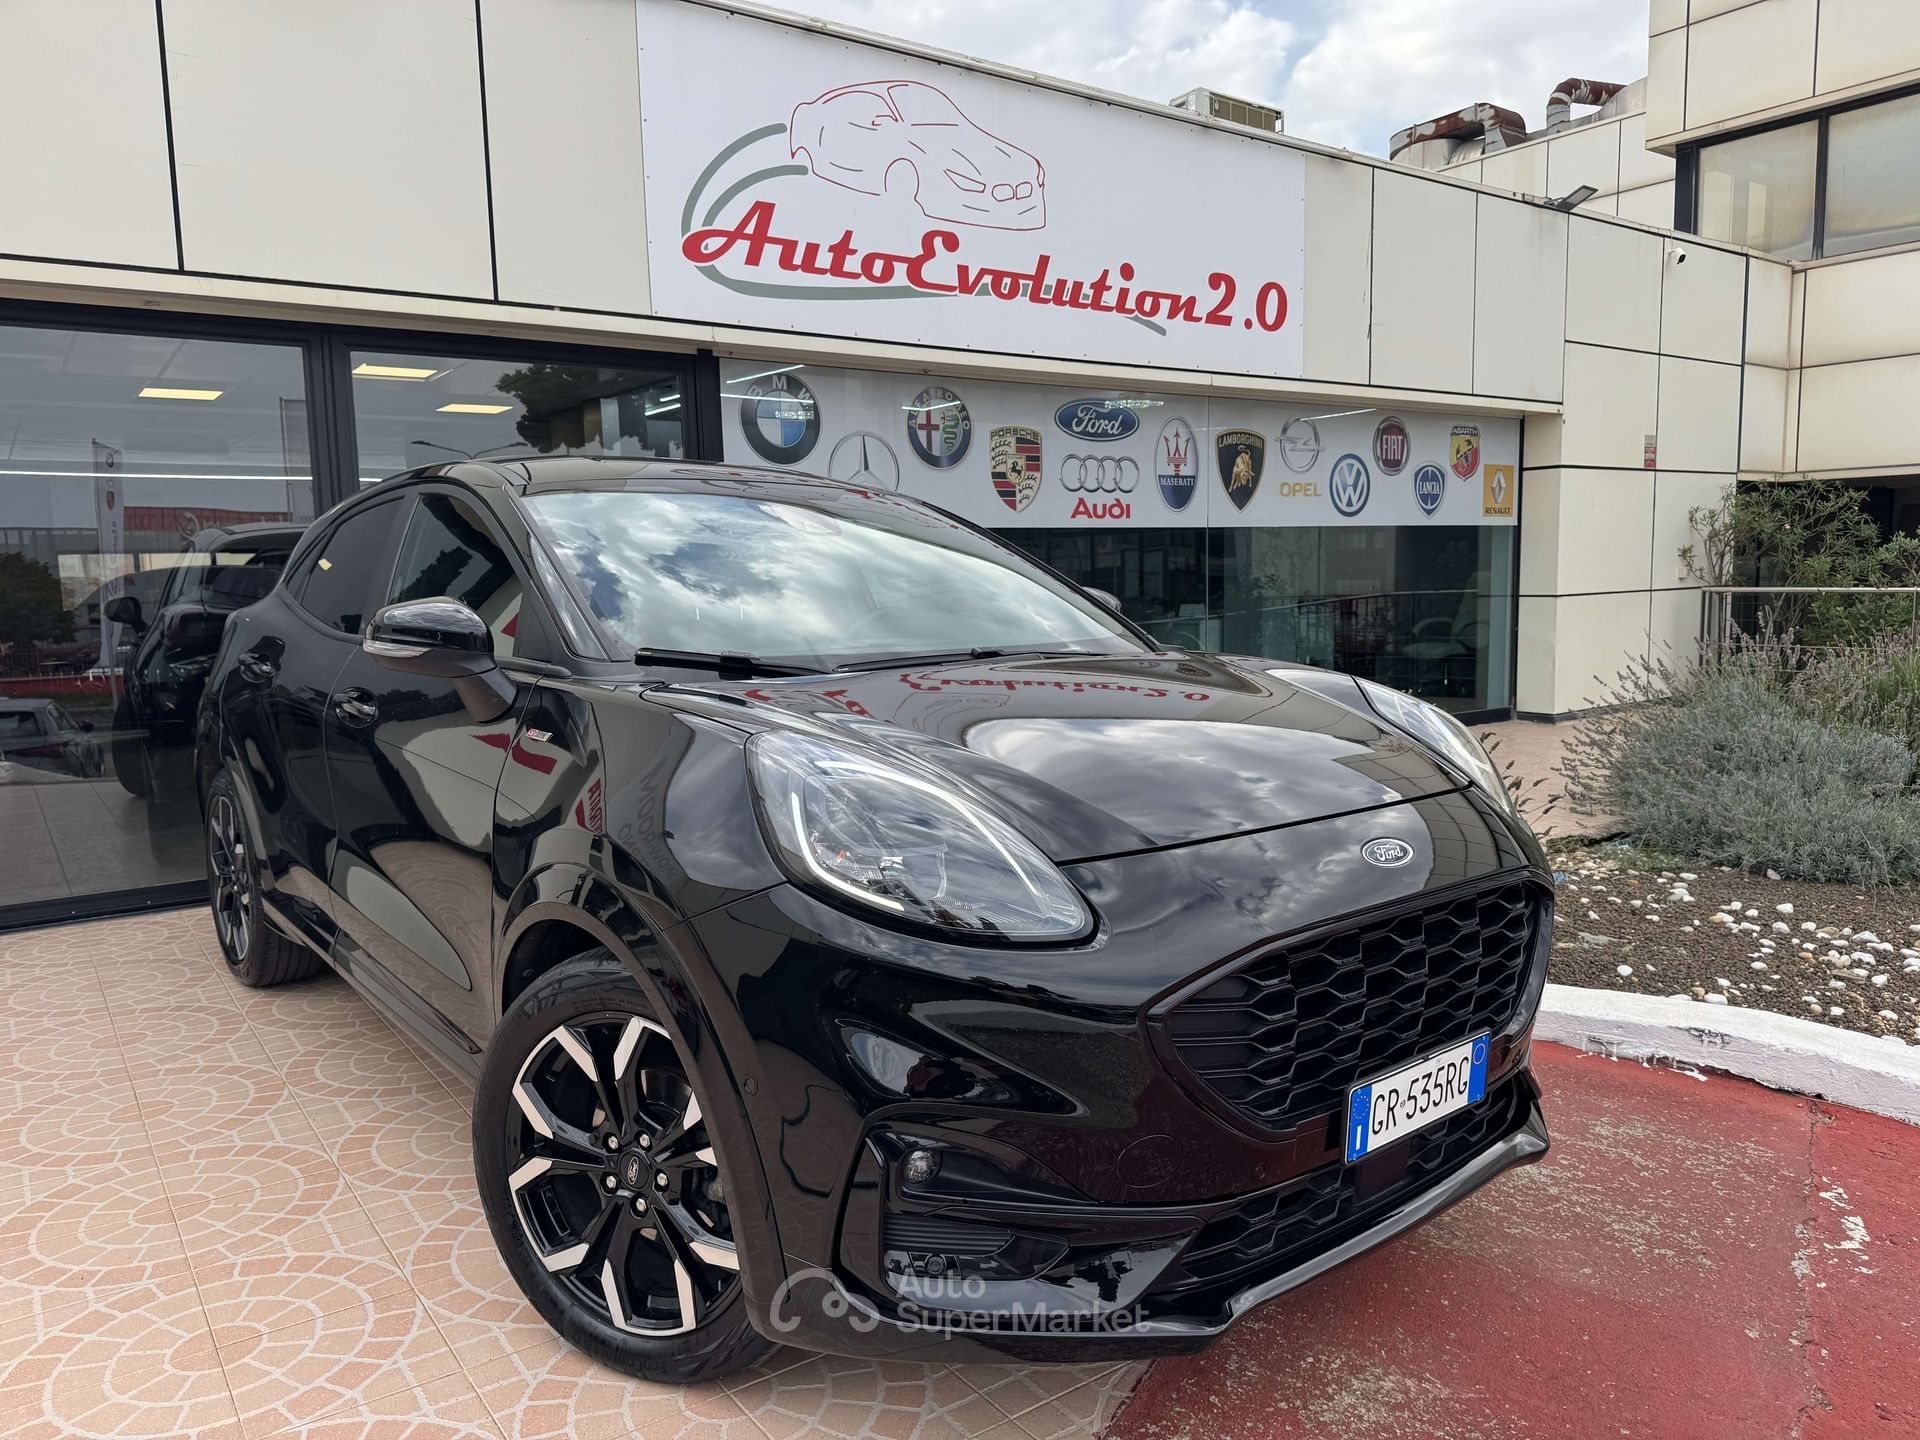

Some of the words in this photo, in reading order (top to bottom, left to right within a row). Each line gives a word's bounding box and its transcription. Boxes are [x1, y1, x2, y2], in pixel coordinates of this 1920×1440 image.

[747, 374, 813, 405] BMW
[1071, 404, 1123, 435] Ford
[991, 428, 1040, 441] PORSCHE
[1218, 433, 1263, 449] LAMBORGHINI
[1382, 435, 1403, 460] FIAT
[1160, 477, 1195, 487] MASERATI
[1279, 482, 1322, 497] OPEL
[1419, 481, 1440, 495] LANCIA
[1070, 498, 1131, 519] Audi
[1485, 506, 1511, 515] RENAULT
[1374, 844, 1404, 861] Ford
